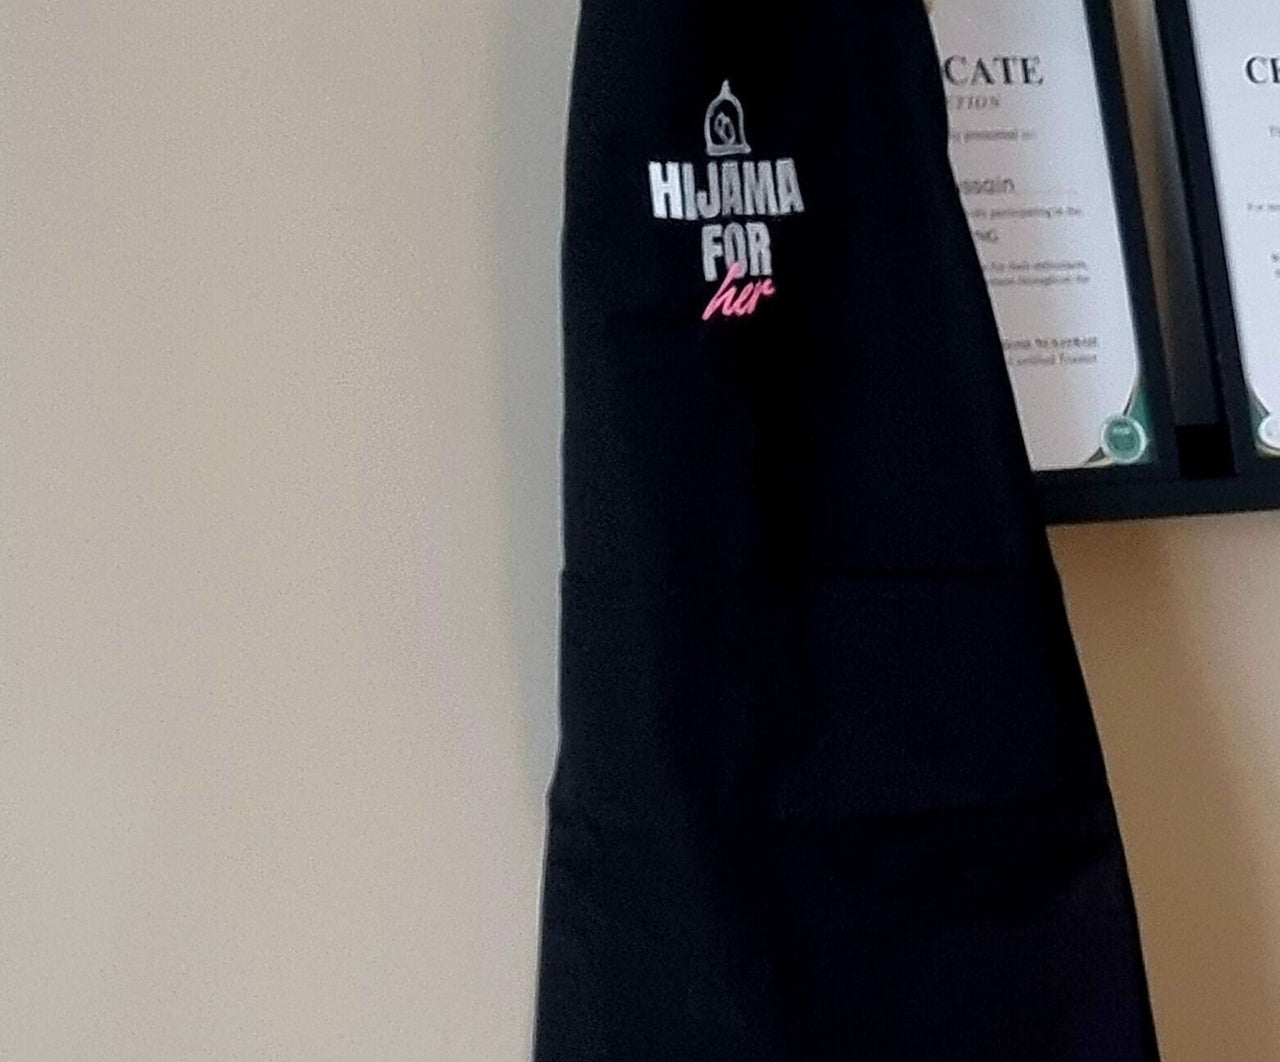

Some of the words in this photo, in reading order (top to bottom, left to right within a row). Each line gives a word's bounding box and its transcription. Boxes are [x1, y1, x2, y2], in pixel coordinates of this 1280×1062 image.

[649, 158, 804, 220] HIJAMA
[701, 222, 772, 281] FOR
[702, 261, 775, 320] her
